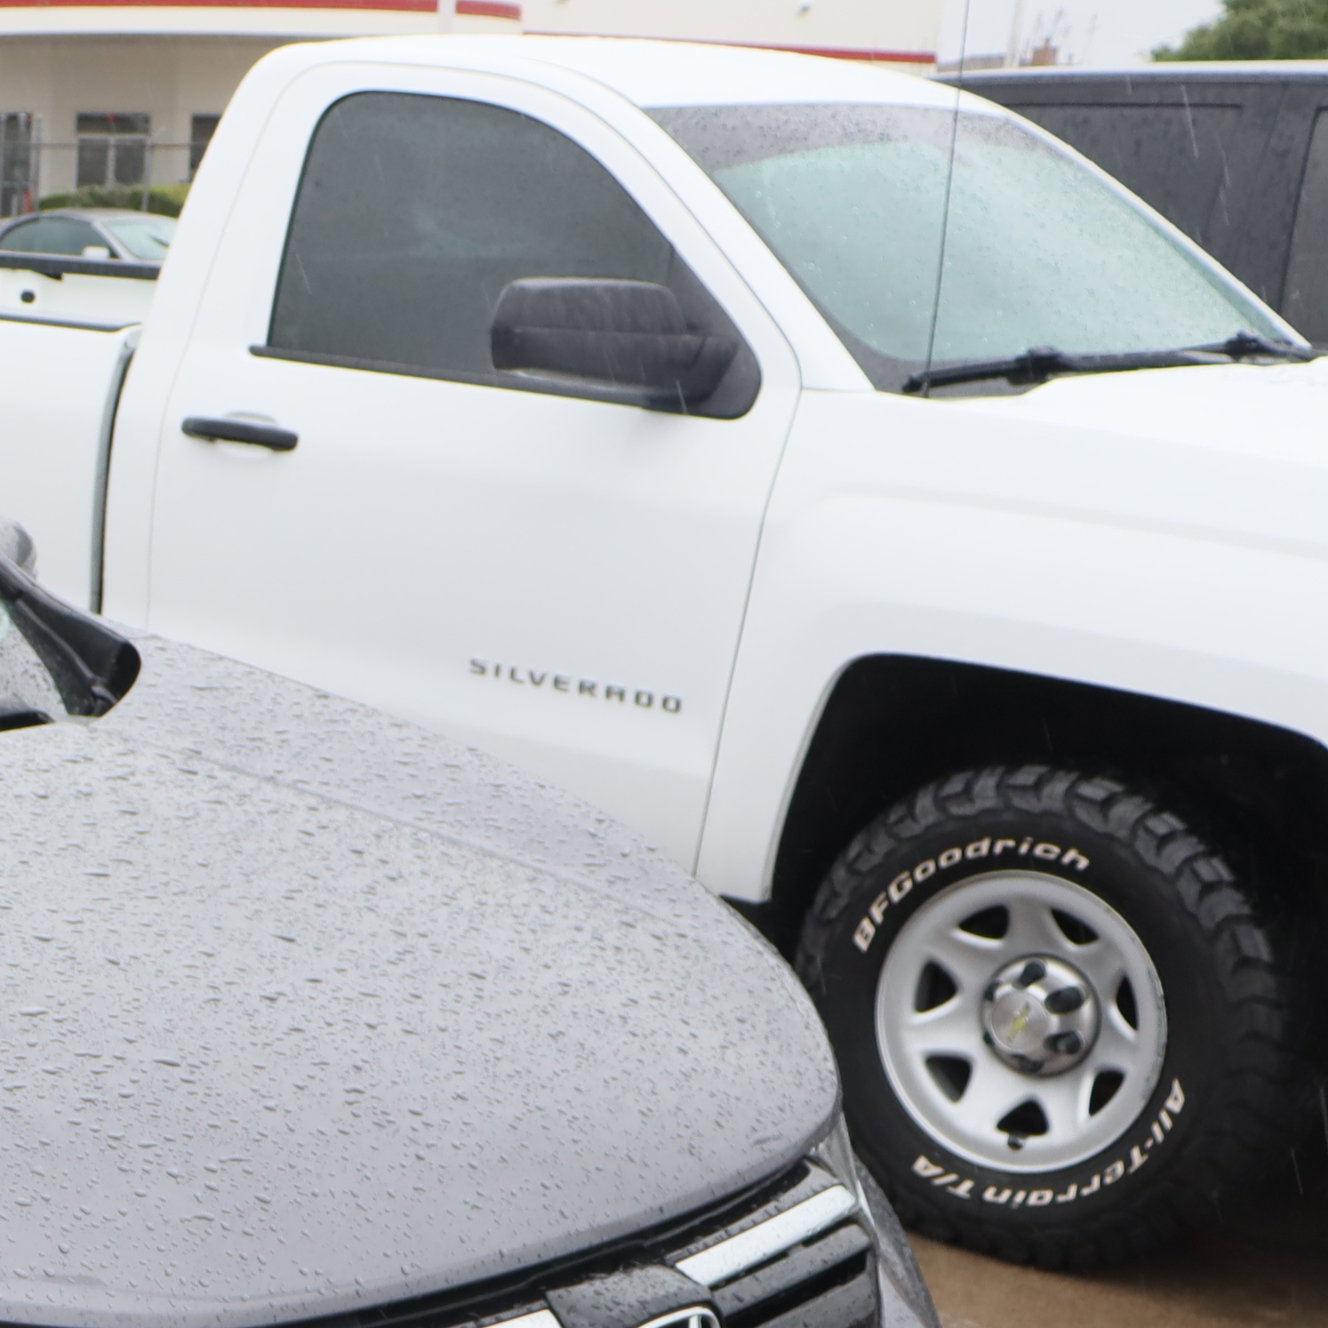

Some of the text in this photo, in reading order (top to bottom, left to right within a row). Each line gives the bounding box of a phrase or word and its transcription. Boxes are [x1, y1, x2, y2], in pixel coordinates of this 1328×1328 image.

[469, 657, 682, 714] SILVERADO
[852, 837, 1090, 953] BFGoodrich
[911, 1155, 975, 1199] T/A
